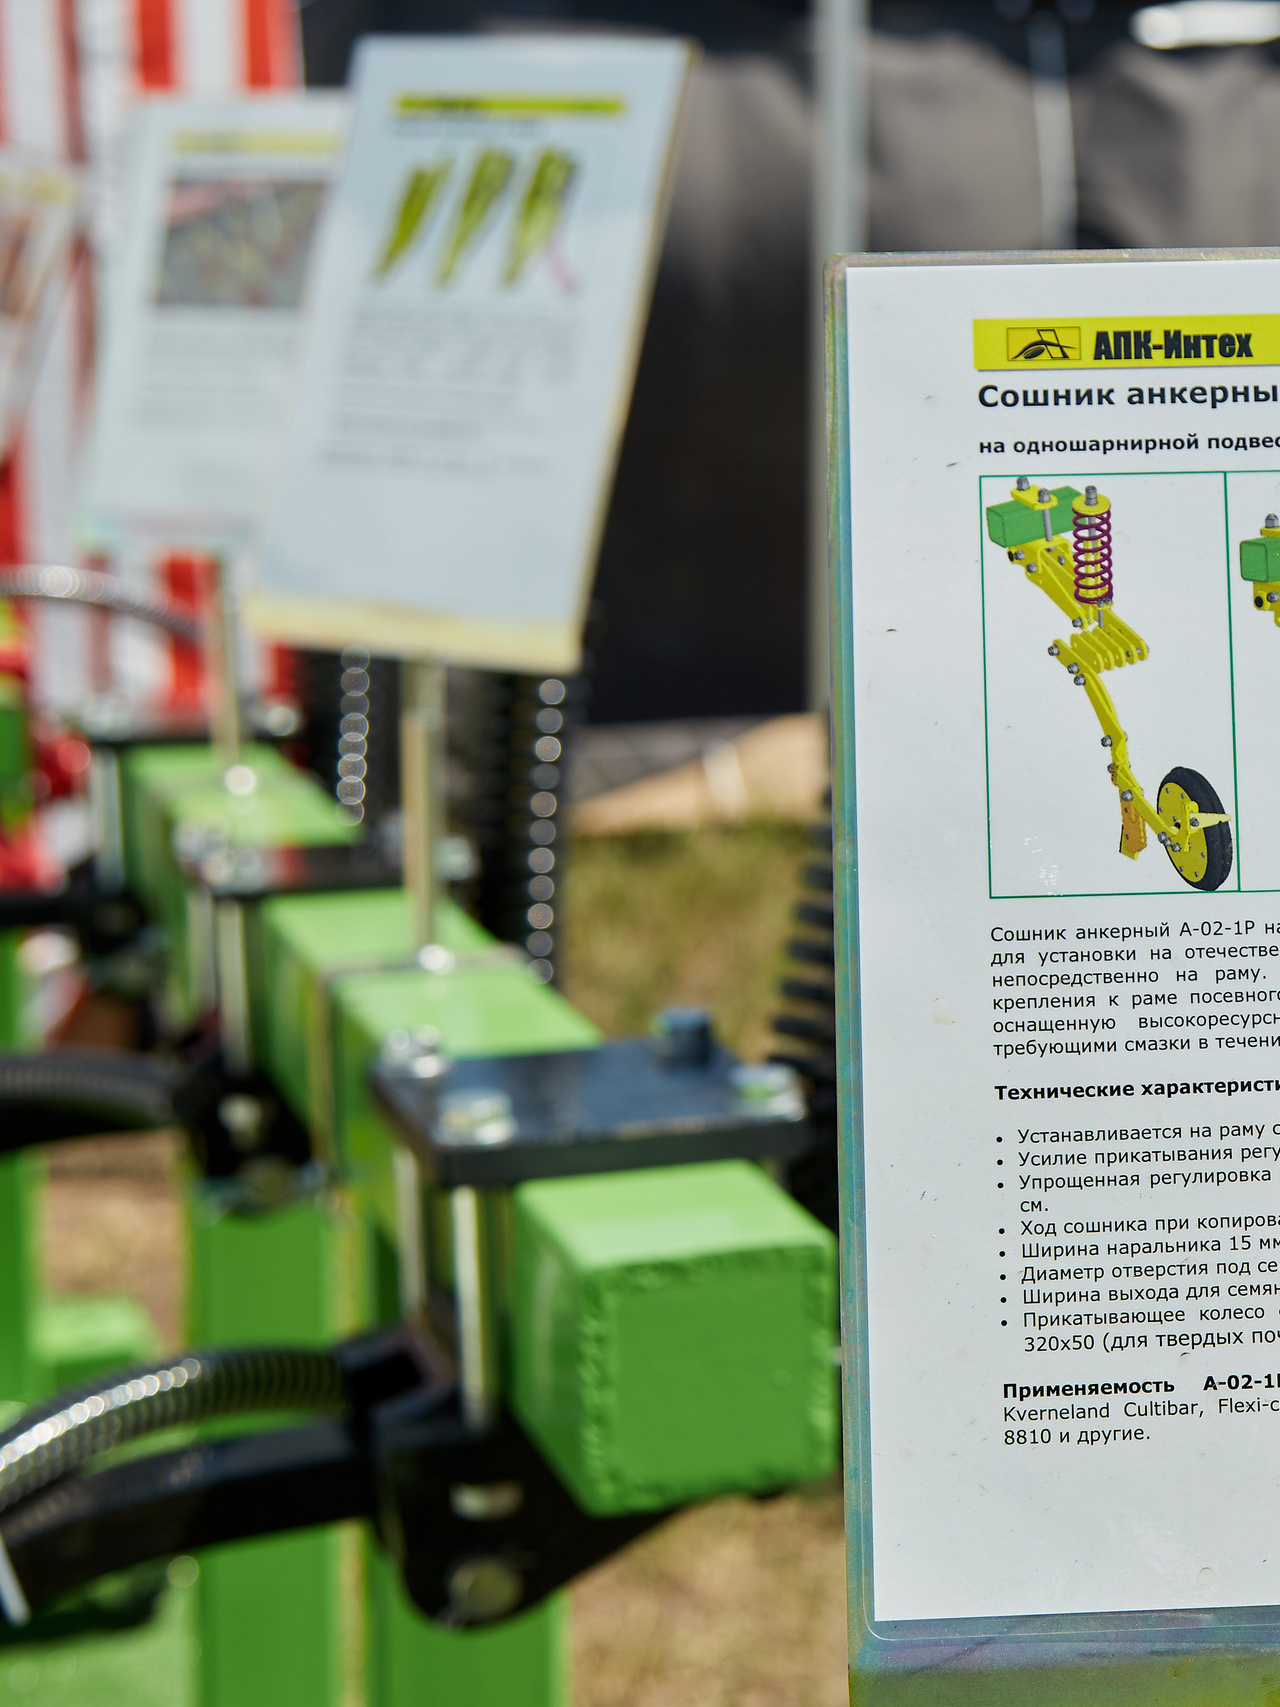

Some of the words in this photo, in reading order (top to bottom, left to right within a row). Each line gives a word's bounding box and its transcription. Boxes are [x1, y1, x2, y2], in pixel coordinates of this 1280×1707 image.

[1093, 329, 1254, 361] АПК-Интех
[978, 384, 1116, 408] Сошник
[979, 440, 1006, 454] на
[1012, 432, 1199, 456] одношарнирной
[990, 926, 1067, 943] Сошник
[1075, 921, 1170, 943] анкерный
[990, 952, 1025, 968] для
[1037, 948, 1137, 968] установки
[1149, 947, 1172, 961] на
[992, 970, 1160, 990] непосредственно
[1175, 969, 1198, 983] на
[1215, 967, 1267, 985] раму.
[992, 995, 1096, 1014] крепления
[1108, 994, 1120, 1007] к
[1131, 992, 1178, 1010] раме
[992, 1017, 1117, 1035] оснащенную
[992, 1038, 1117, 1060] требующими
[1124, 1037, 1191, 1052] смазки
[1198, 1037, 1209, 1050] в
[993, 1083, 1135, 1101] Технические
[1017, 1126, 1183, 1145] Устанавливается
[1189, 1125, 1212, 1139] на
[1219, 1123, 1266, 1142] раму
[1017, 1151, 1088, 1167] Усилие
[1094, 1147, 1233, 1168] прикатывания
[1018, 1173, 1140, 1193] Упрощенная
[1149, 1169, 1272, 1190] регулировка
[1019, 1200, 1049, 1213] см.
[1020, 1219, 1058, 1238] Ход
[1063, 1219, 1148, 1235] сошника
[1155, 1217, 1190, 1235] при
[1021, 1242, 1100, 1262] Ширина
[1106, 1239, 1222, 1259] наральника
[1229, 1234, 1252, 1252] 15
[1020, 1265, 1105, 1285] Диаметр
[1111, 1261, 1209, 1278] отверстия
[1216, 1261, 1252, 1277] под
[1023, 1288, 1101, 1308] Ширина
[1108, 1286, 1180, 1303] выхода
[1185, 1285, 1221, 1302] для
[1023, 1309, 1186, 1331] Прикатывающее
[1199, 1306, 1266, 1322] колесо
[1102, 1331, 1148, 1354] (для
[1154, 1331, 1245, 1351] твердых
[1003, 1377, 1176, 1400] Применяемость
[1003, 1401, 1110, 1423] Kverneland
[1123, 1399, 1204, 1419] Cultibar,
[1003, 1428, 1052, 1446] 8810
[1059, 1430, 1070, 1444] и
[1076, 1427, 1151, 1446] другие.
